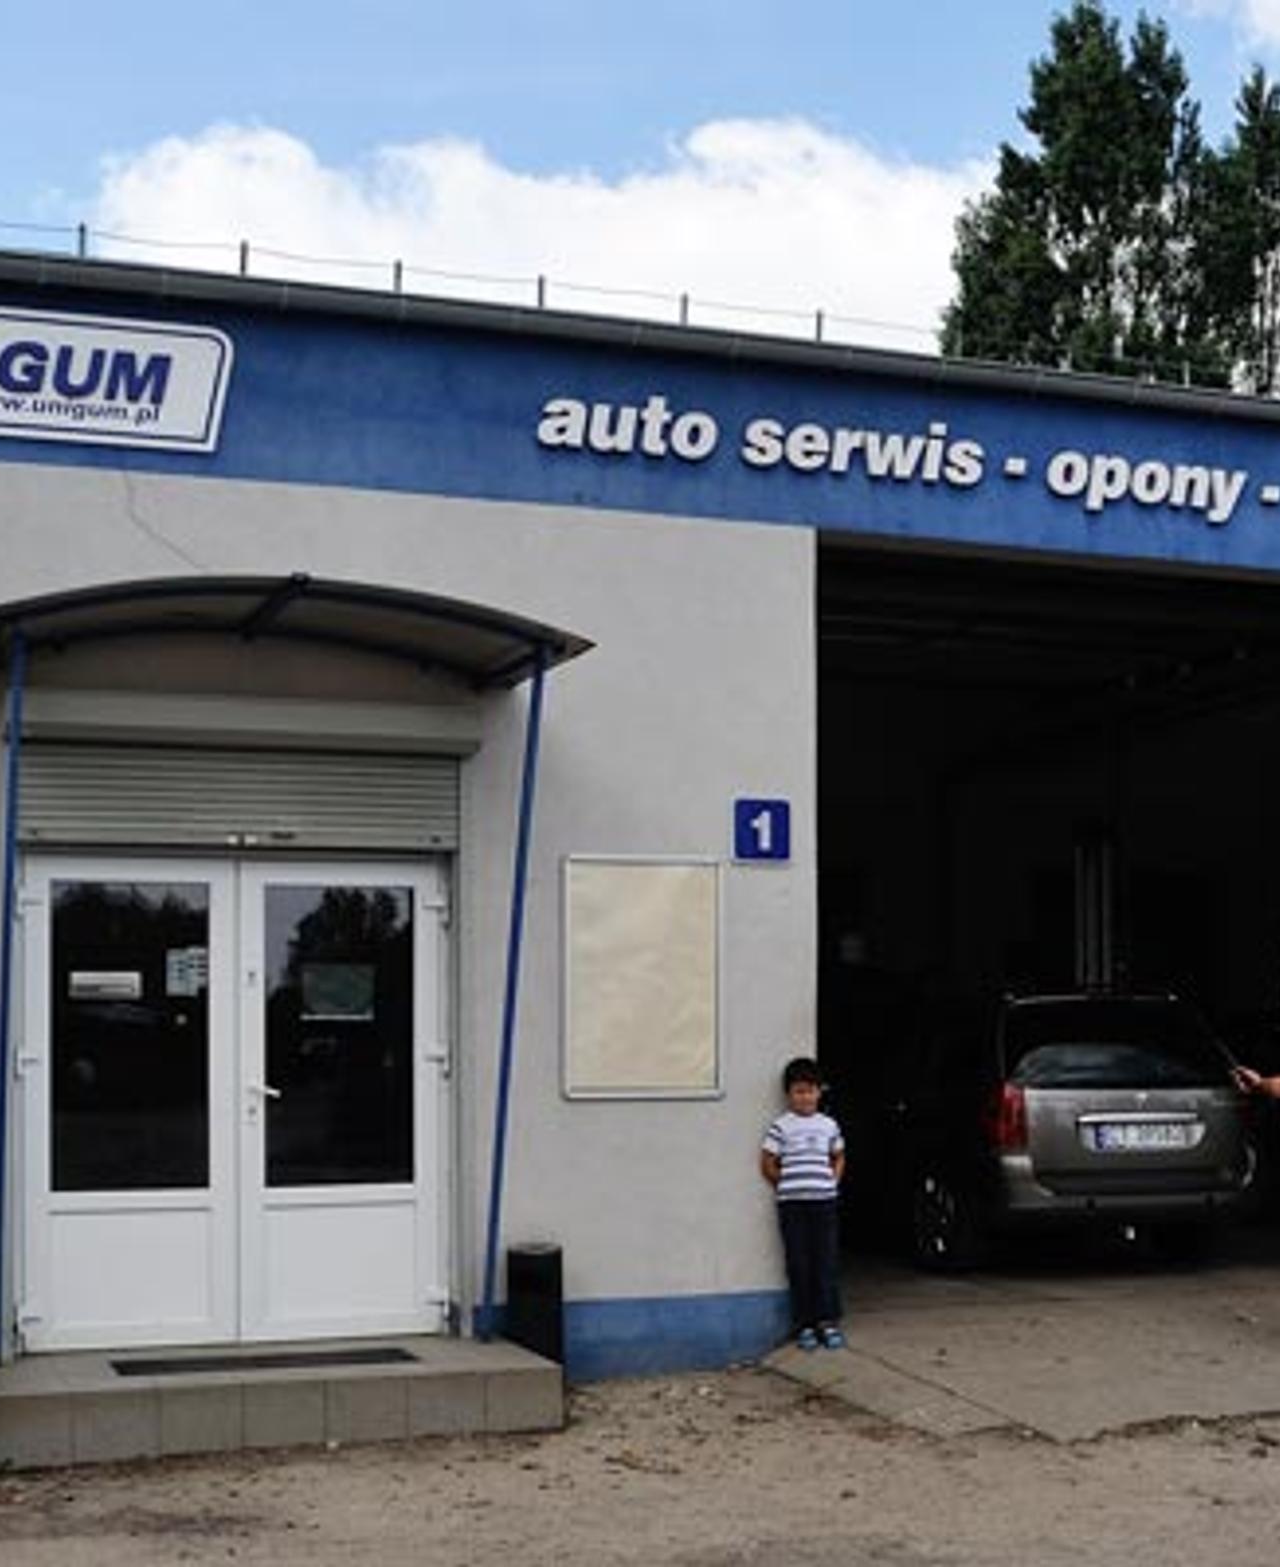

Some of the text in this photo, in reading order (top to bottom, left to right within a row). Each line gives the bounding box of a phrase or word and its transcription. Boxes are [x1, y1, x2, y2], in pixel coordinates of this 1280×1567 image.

[537, 395, 718, 461] auto
[741, 417, 985, 486] serwis
[1046, 448, 1248, 523] opony
[750, 810, 772, 851] 1
